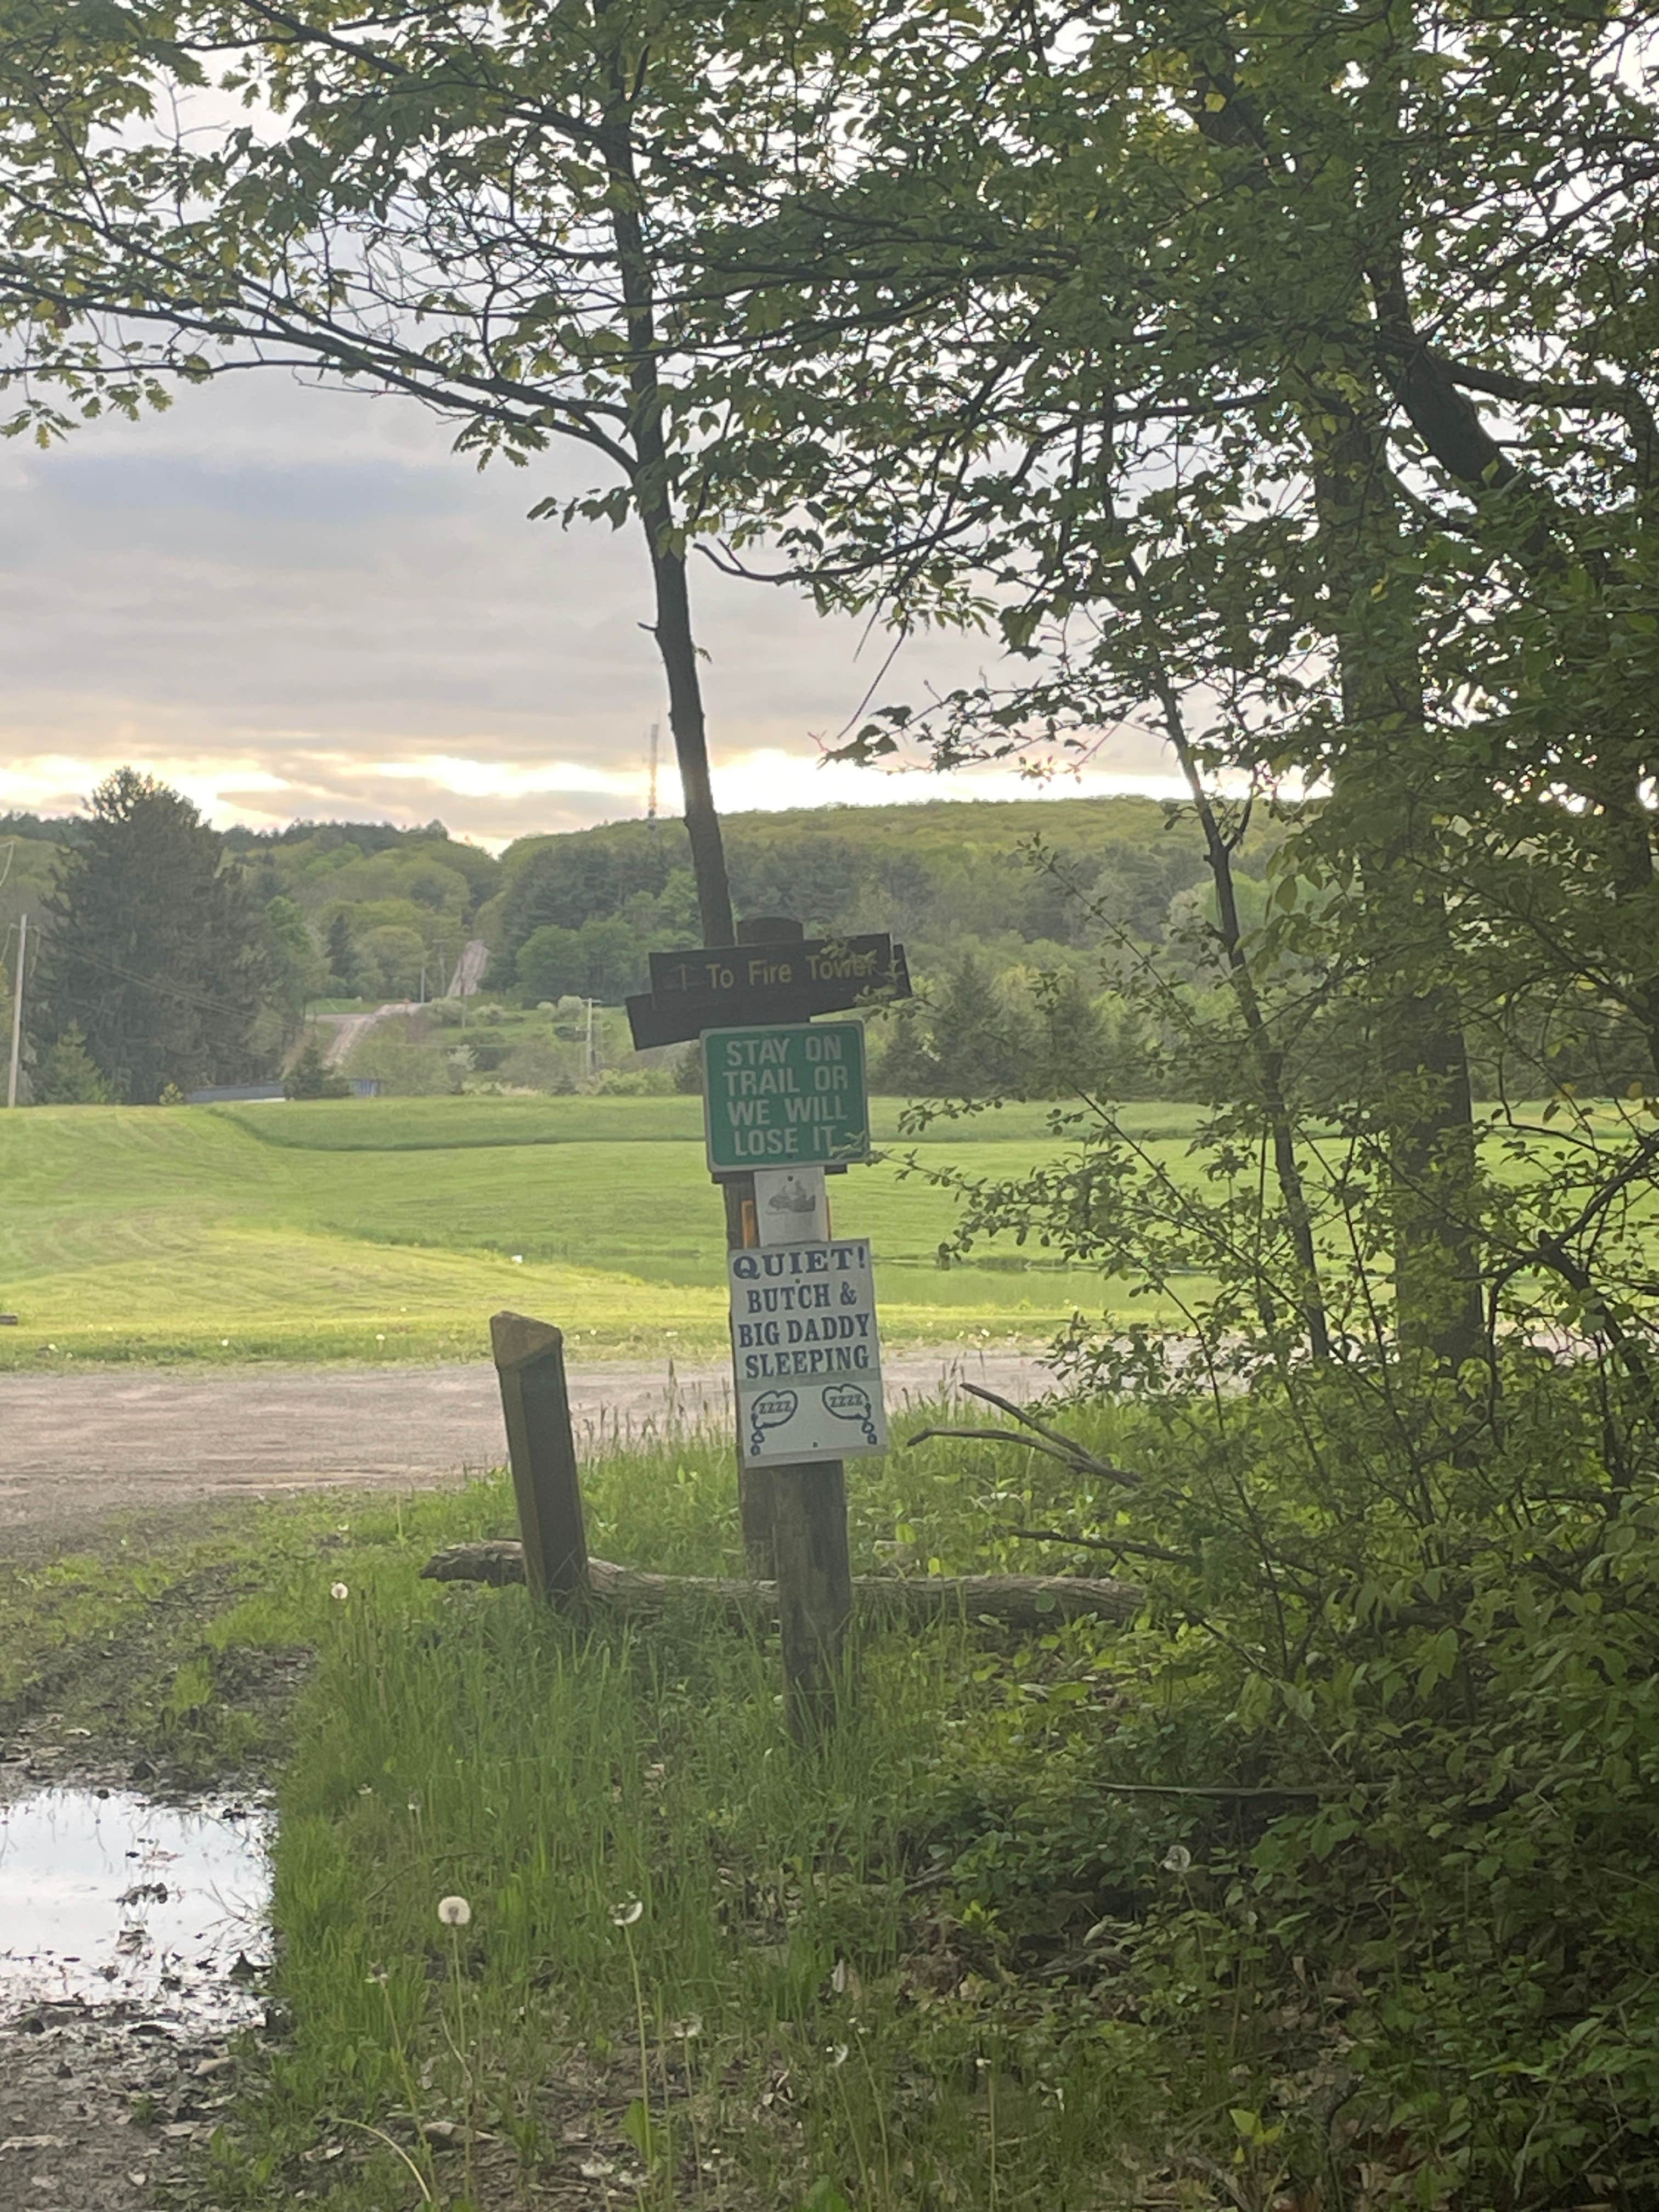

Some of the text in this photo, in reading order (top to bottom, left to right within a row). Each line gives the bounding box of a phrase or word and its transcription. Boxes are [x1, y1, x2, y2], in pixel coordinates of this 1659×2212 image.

[706, 963, 734, 989] To
[748, 960, 792, 986] Fire
[726, 1034, 842, 1067] STAY ON
[723, 1065, 848, 1097] TRAIL OR
[727, 1096, 848, 1126] WE WILL
[735, 1125, 838, 1157] LOSE IT
[733, 1246, 865, 1280] QUIET!
[747, 1281, 857, 1313] BUTCH &
[738, 1313, 870, 1347] BIG DADDY
[746, 1345, 869, 1379] SLEEPING
